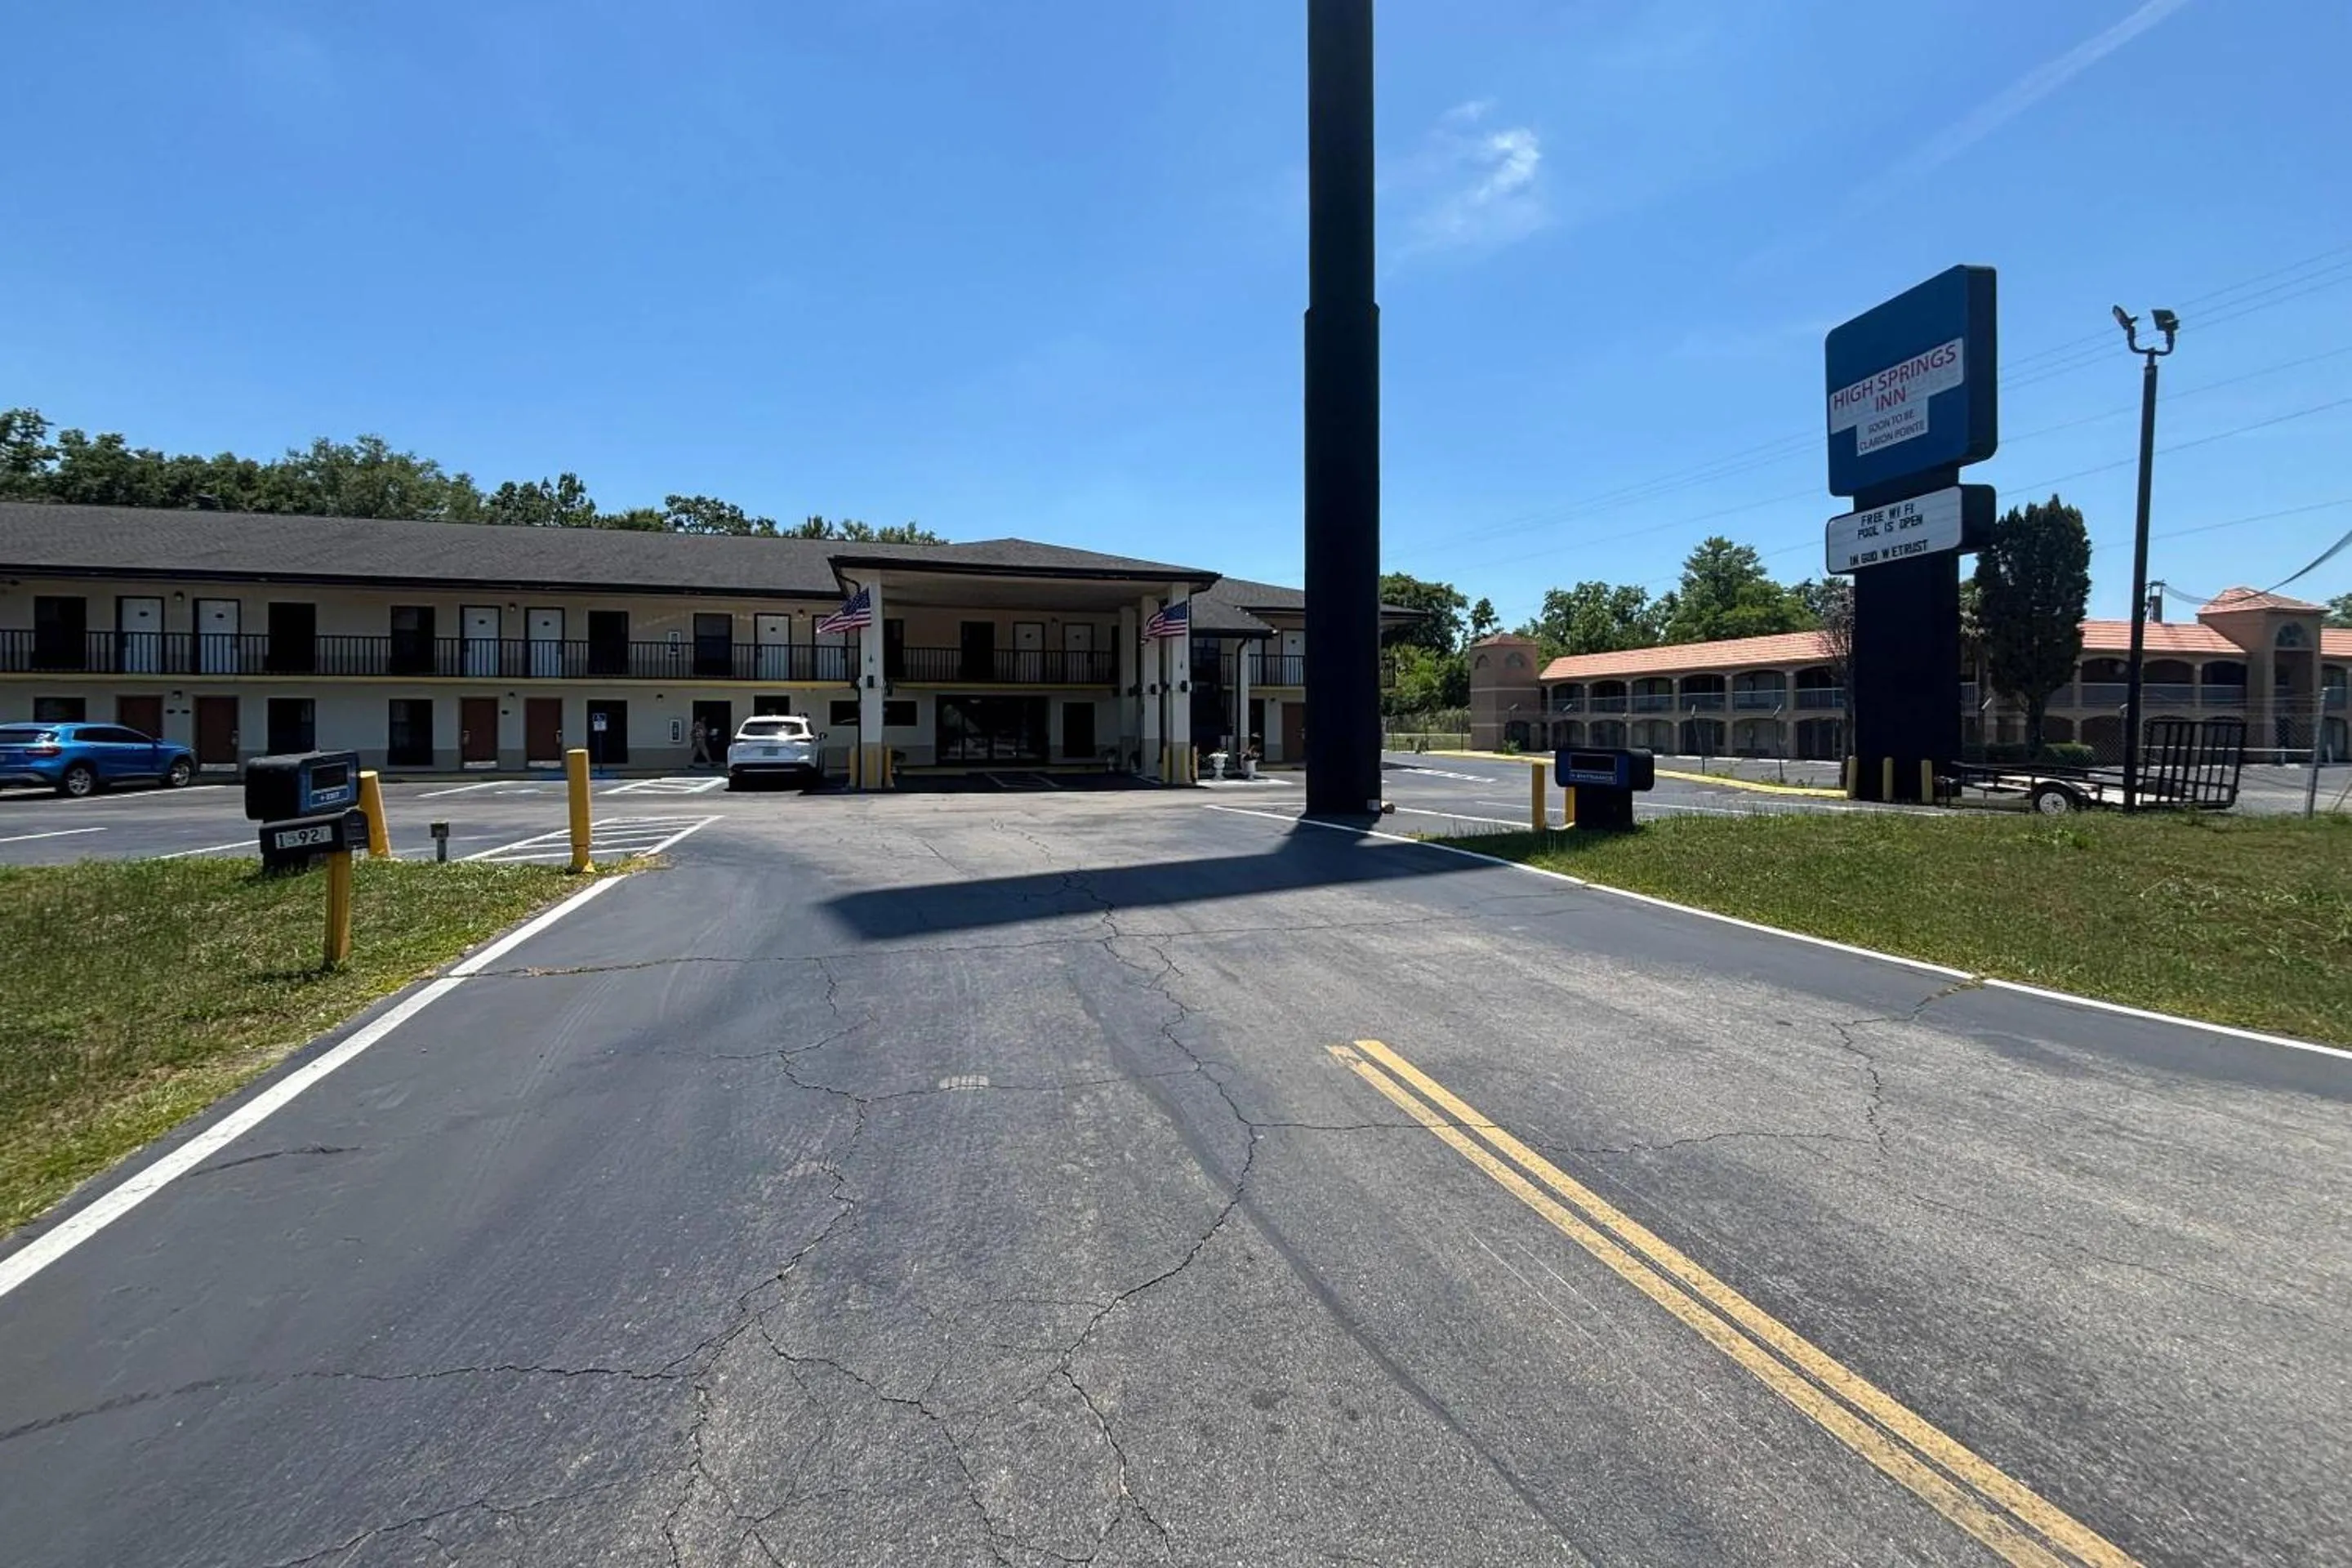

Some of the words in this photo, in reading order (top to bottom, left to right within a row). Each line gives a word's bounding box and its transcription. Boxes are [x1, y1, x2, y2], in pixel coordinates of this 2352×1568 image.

[1833, 380, 1873, 410] HIGH
[1878, 344, 1956, 391] SPRINGS
[1875, 385, 1906, 412] INN
[1869, 417, 1890, 434] SOON
[1891, 413, 1903, 425] TO
[1860, 430, 1893, 451] CLARION
[1857, 528, 1878, 539] POOL
[1885, 521, 1894, 532] IS
[1900, 514, 1923, 529] OPEN
[1861, 510, 1884, 526] FREE
[1850, 555, 1859, 566] IN
[1861, 551, 1878, 564] GOD
